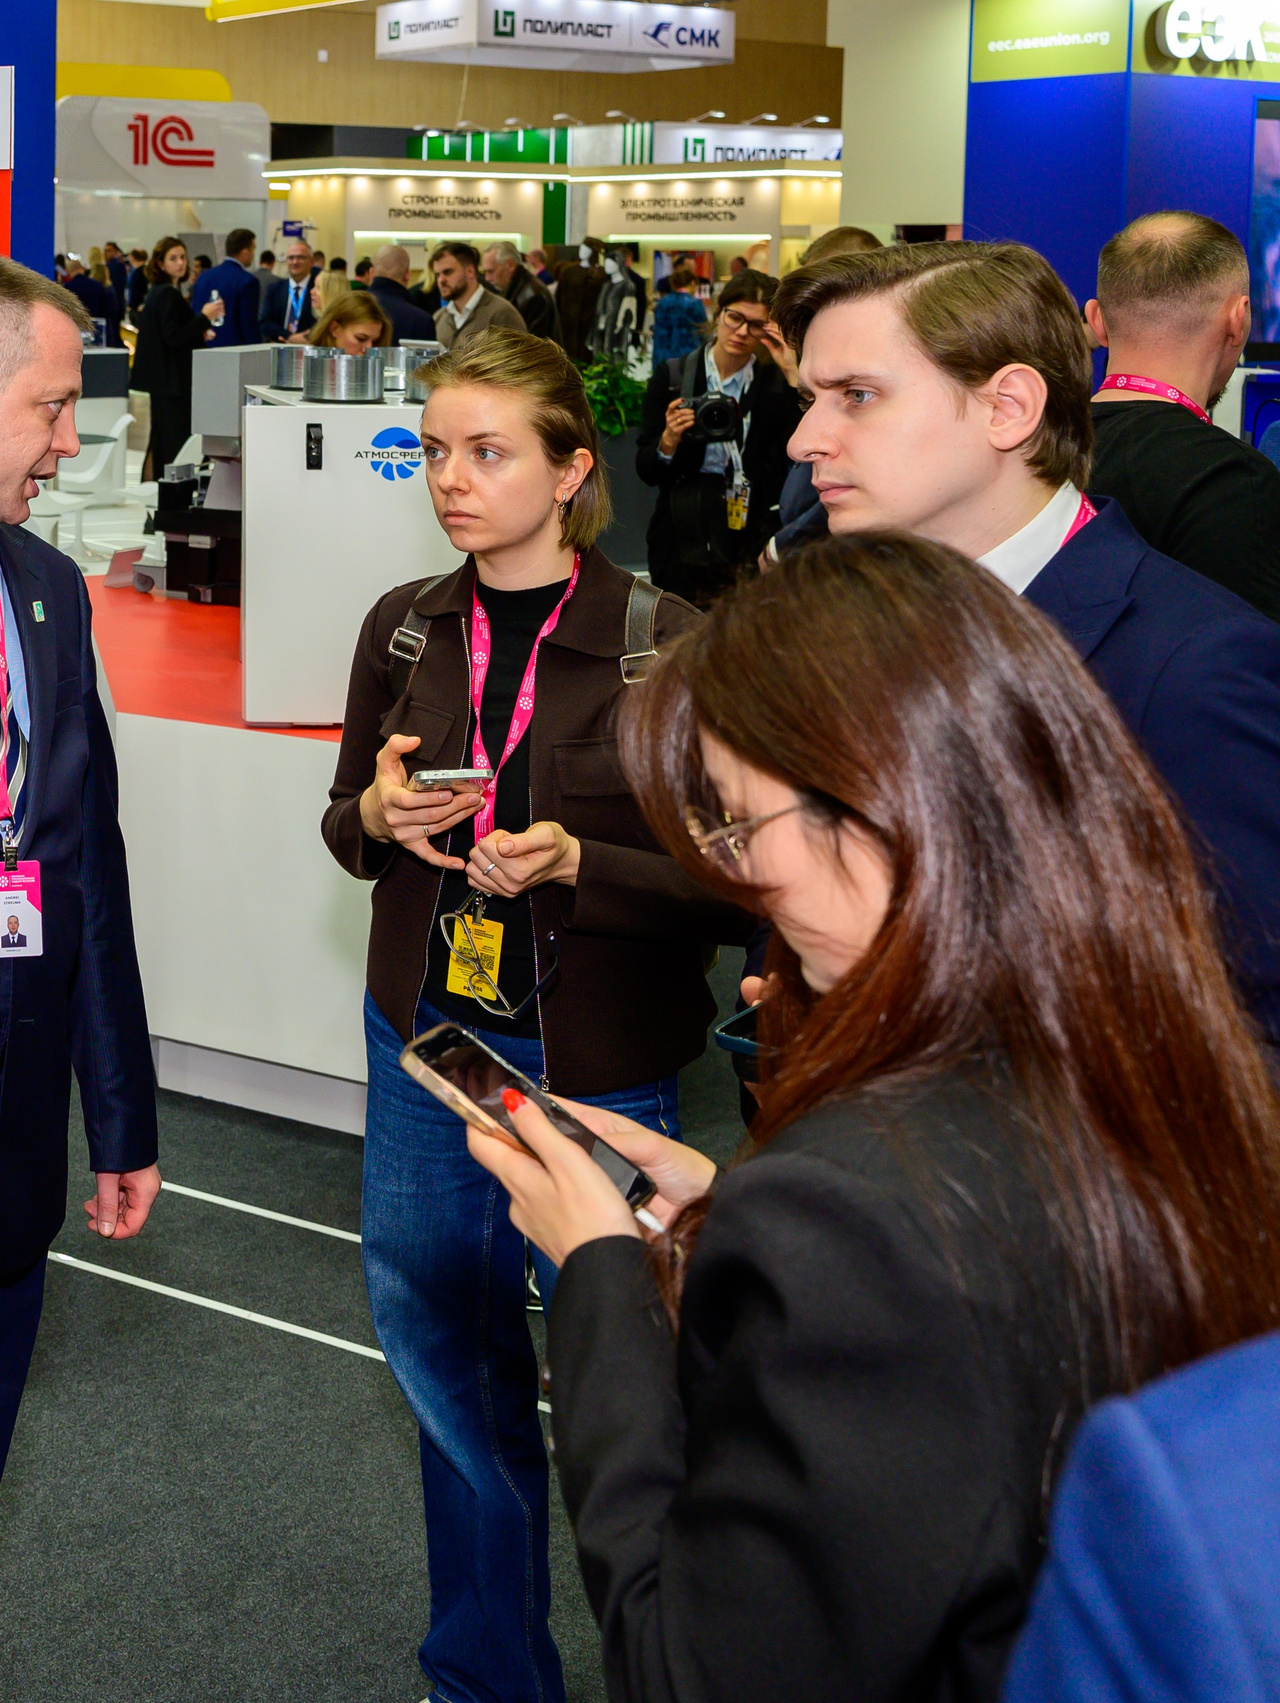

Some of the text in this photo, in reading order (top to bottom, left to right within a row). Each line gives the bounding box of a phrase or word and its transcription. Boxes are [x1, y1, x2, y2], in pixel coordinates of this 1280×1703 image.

[523, 19, 720, 48] ПОЛИПЛАСТ СМК
[987, 31, 1110, 52] eec.eaeunion.org
[402, 195, 489, 206] СТРОИТЕЛЬНАЯ
[621, 197, 745, 209] ЭЛЕКТРОТЕХНИЧЕСКАЯ
[388, 208, 502, 220] ПРОМЫШЛЕННОСТЬ
[626, 211, 737, 223] ПРОМЫШЛЕННОСТЬ
[354, 451, 426, 460] АТМОСФЕР
